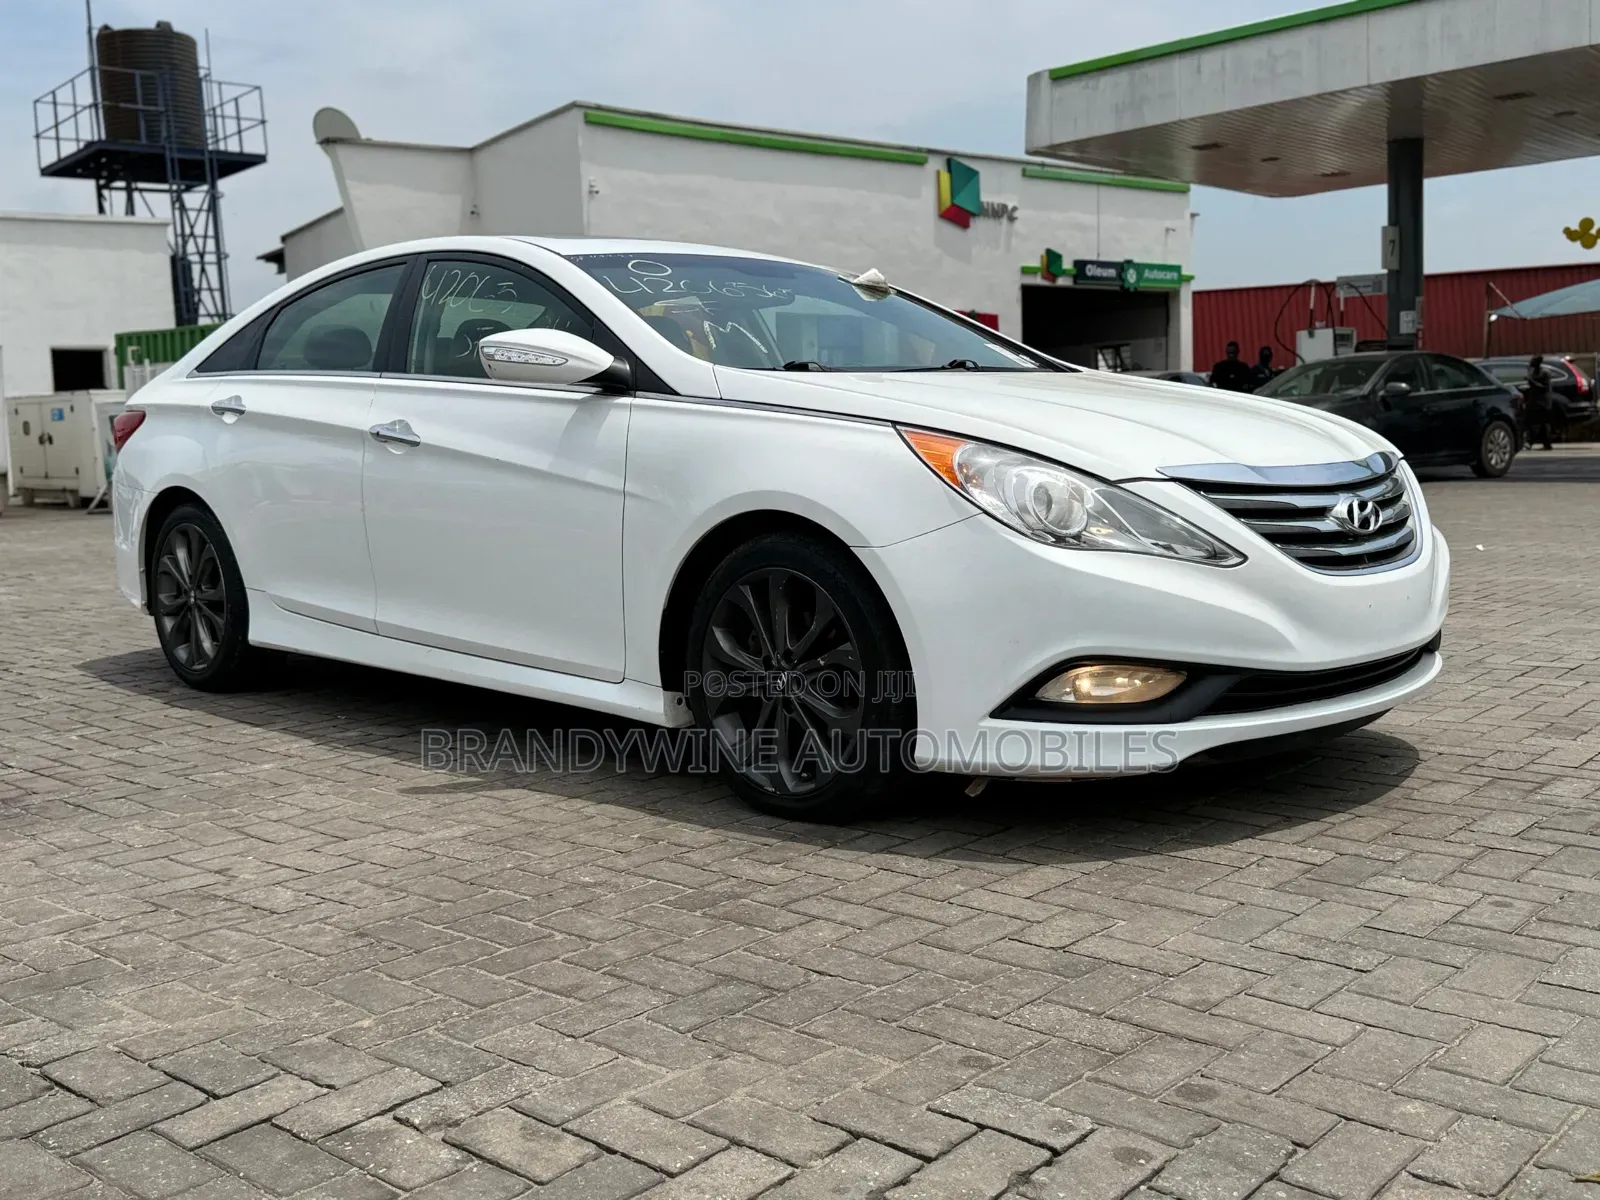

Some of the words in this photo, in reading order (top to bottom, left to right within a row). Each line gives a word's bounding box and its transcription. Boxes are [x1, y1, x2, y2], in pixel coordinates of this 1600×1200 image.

[1387, 239, 1397, 258] 7
[1085, 264, 1117, 278] Oleum
[1143, 268, 1179, 281] Autocare
